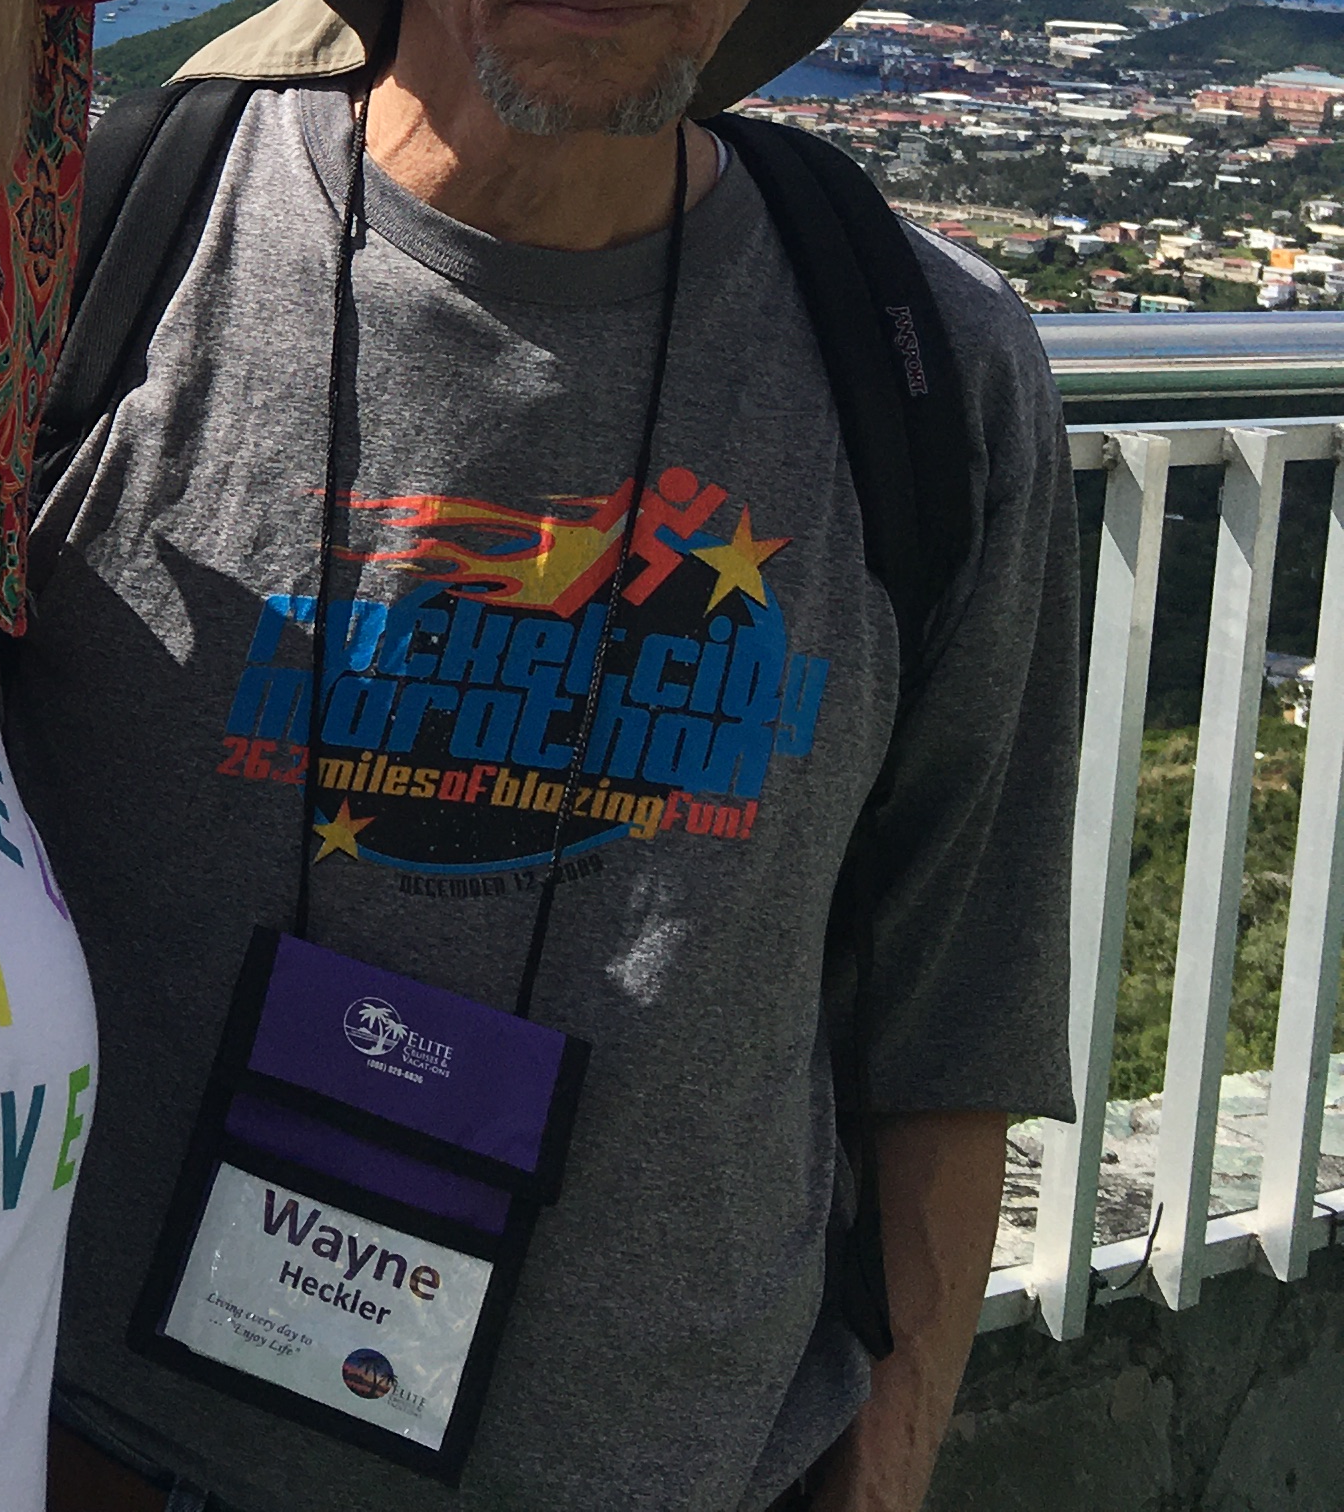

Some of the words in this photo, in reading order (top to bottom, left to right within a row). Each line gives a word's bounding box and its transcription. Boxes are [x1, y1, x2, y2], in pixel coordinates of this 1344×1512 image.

[225, 667, 775, 798] marathon
[407, 1030, 454, 1061] ELITE
[263, 1188, 441, 1301] Wayne
[278, 1260, 391, 1326] Heckler
[276, 1323, 299, 1342] day
[300, 1334, 313, 1346] to
